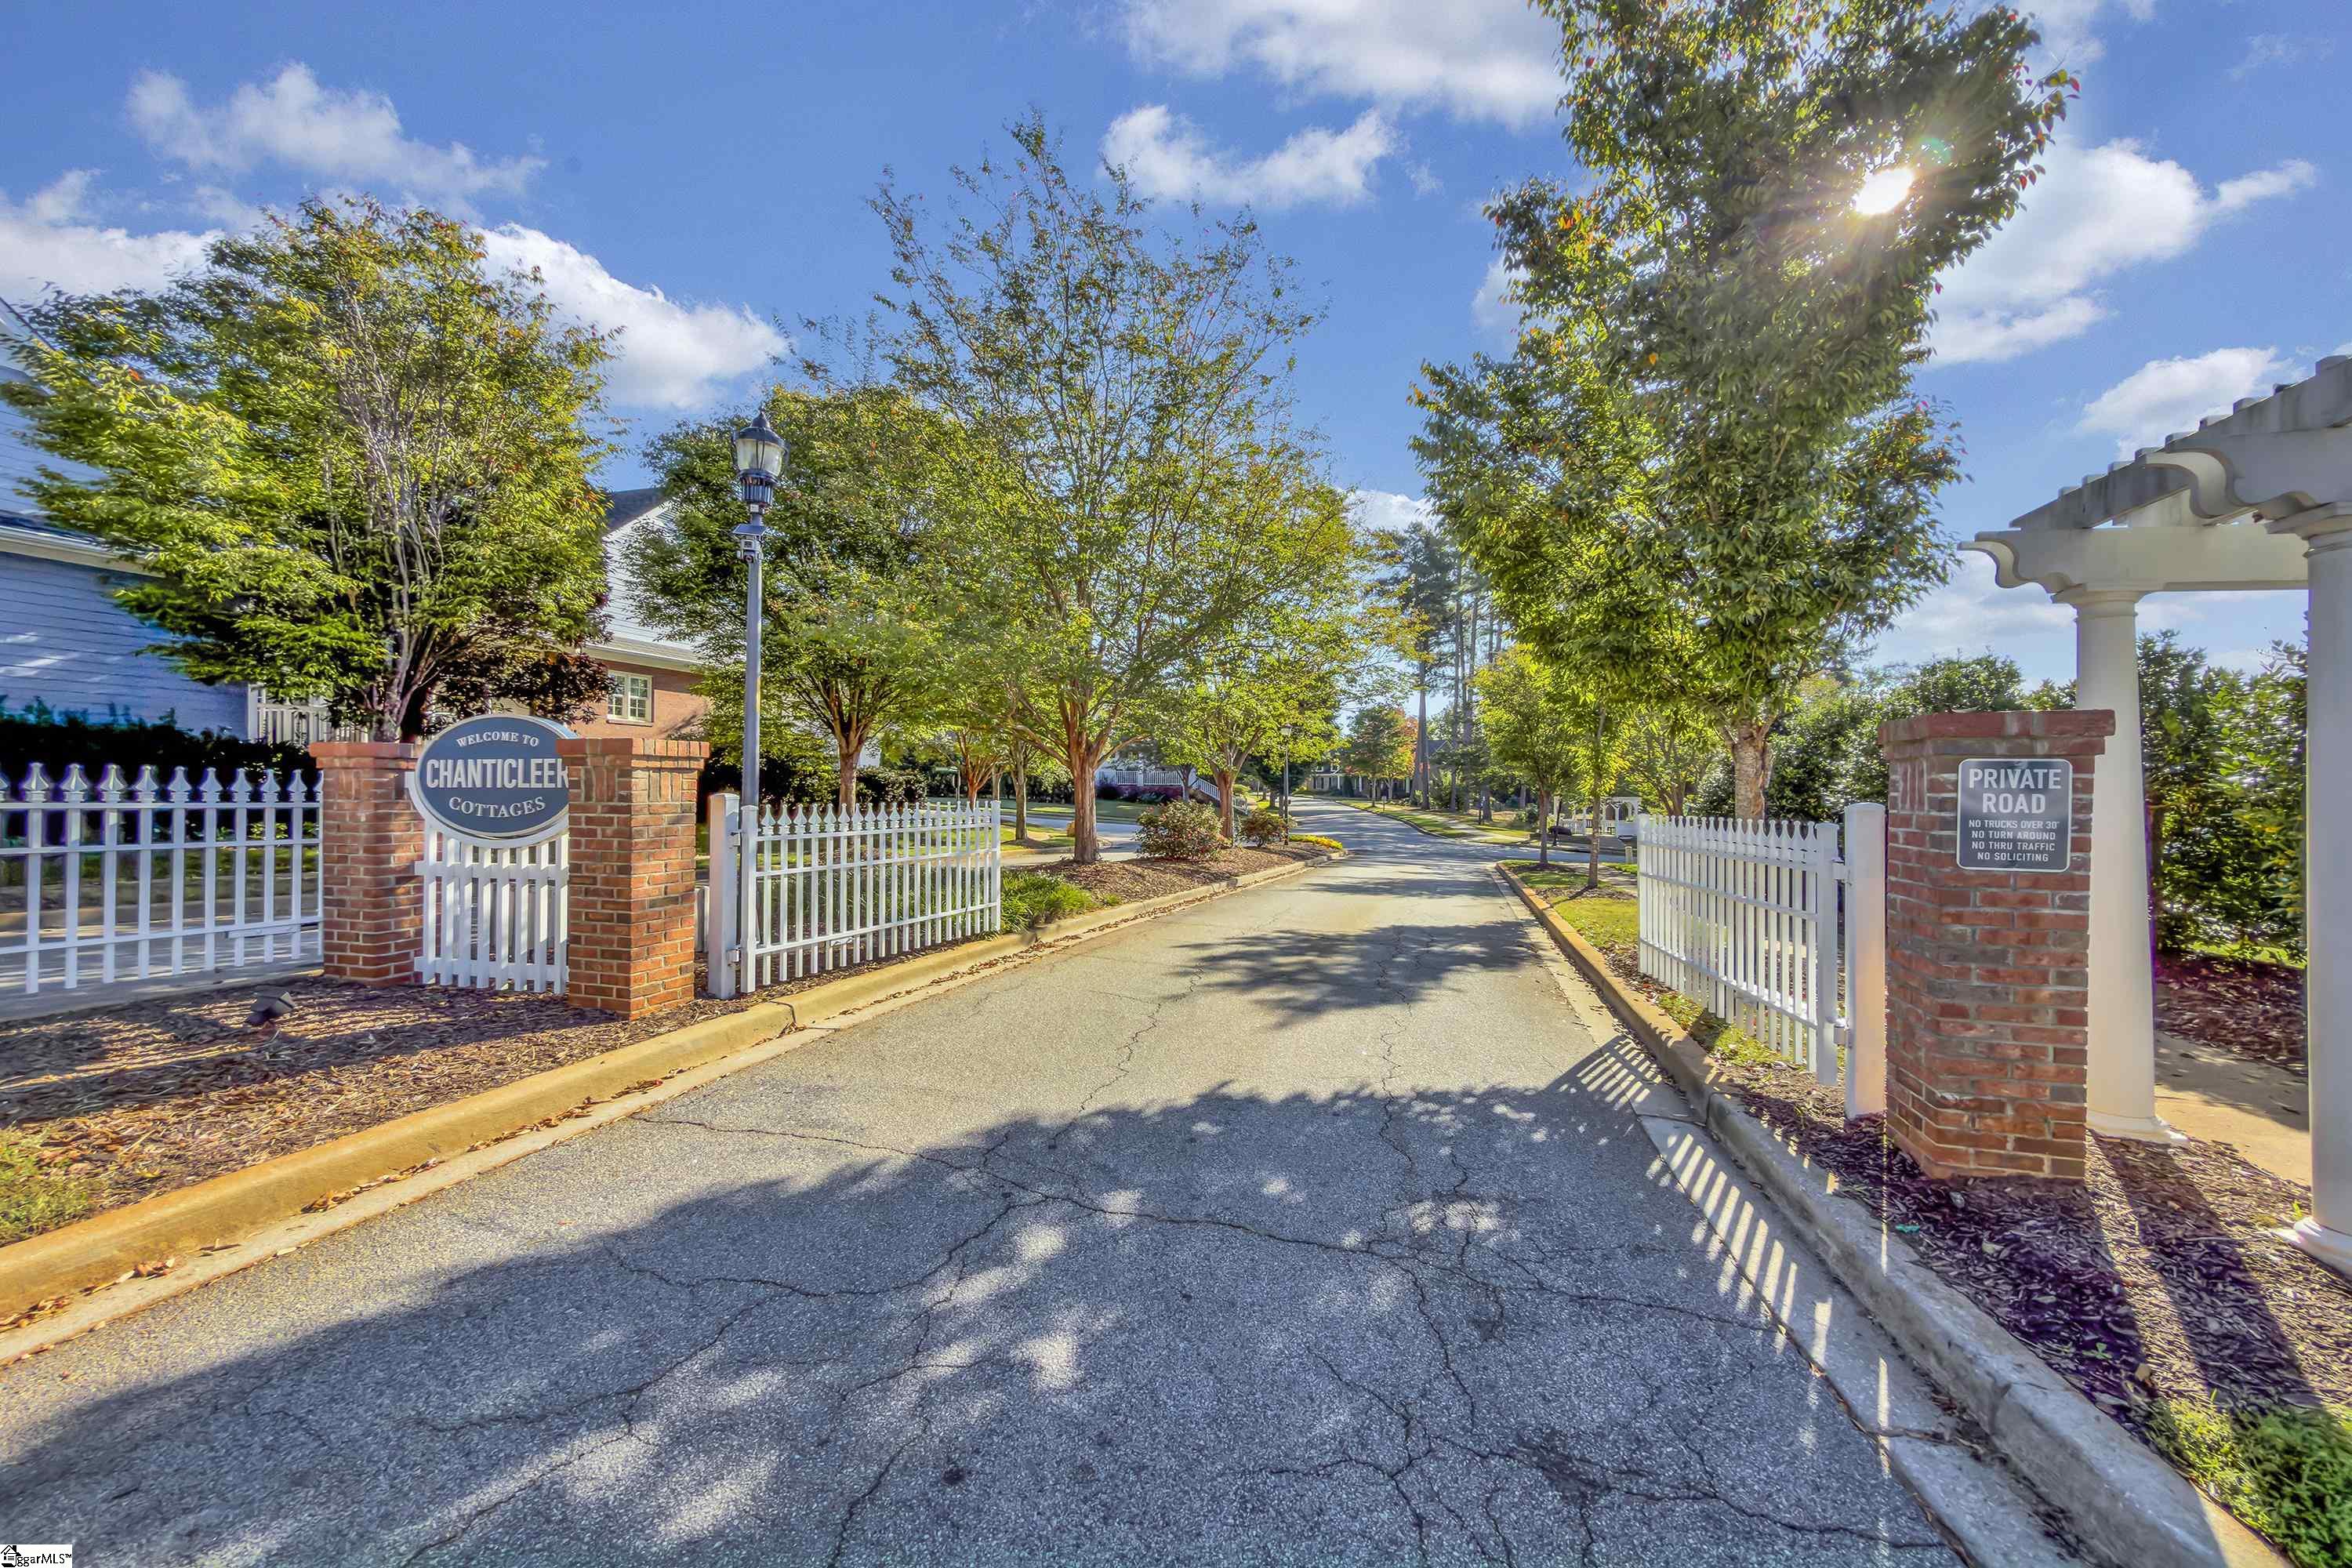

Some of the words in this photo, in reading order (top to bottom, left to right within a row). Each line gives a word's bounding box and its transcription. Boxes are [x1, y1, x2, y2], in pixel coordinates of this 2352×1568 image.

[456, 731, 519, 748] WELCOME
[522, 733, 540, 747] TO
[1969, 768, 2062, 789] PRIVATE
[448, 796, 546, 818] COTTAGES
[1982, 793, 2045, 814] ROAD
[1969, 819, 1981, 828] NO
[1984, 819, 2018, 829] TRUCKS
[2020, 820, 2043, 829] OVER
[1972, 830, 1984, 839] NO
[1989, 830, 2013, 840] TURN
[2016, 831, 2056, 840] AROUND
[1972, 841, 1984, 850] NO
[1989, 841, 2013, 851] THRU
[2016, 842, 2055, 851] TRAFFIC
[1977, 851, 1990, 860] NO
[1994, 852, 2049, 862] SOLICITING
